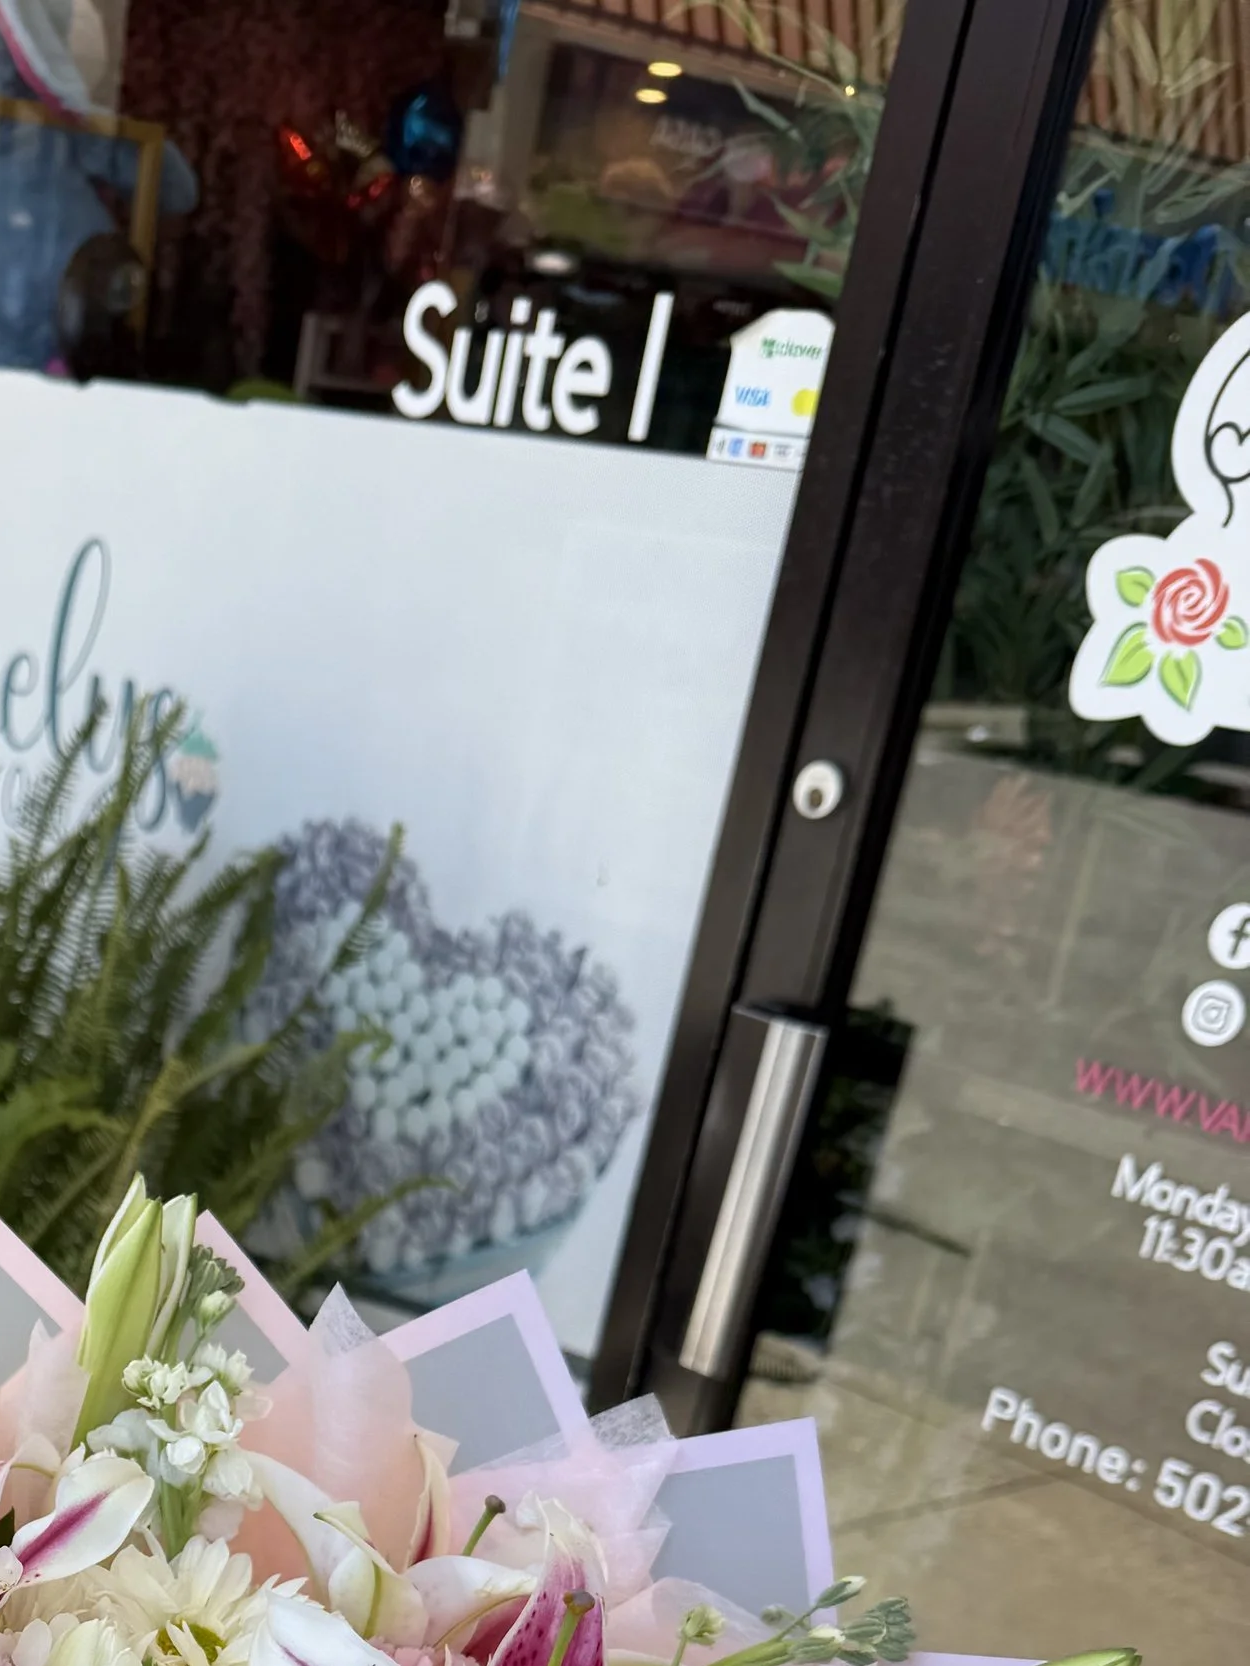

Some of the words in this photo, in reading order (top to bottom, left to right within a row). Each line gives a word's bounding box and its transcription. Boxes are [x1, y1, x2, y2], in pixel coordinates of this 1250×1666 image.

[391, 280, 613, 436] Suite
[735, 385, 772, 408] VISA
[1075, 1056, 1250, 1143] WWW.VA
[980, 1385, 1147, 1493] Phone:
[1185, 1398, 1250, 1464] Clo
